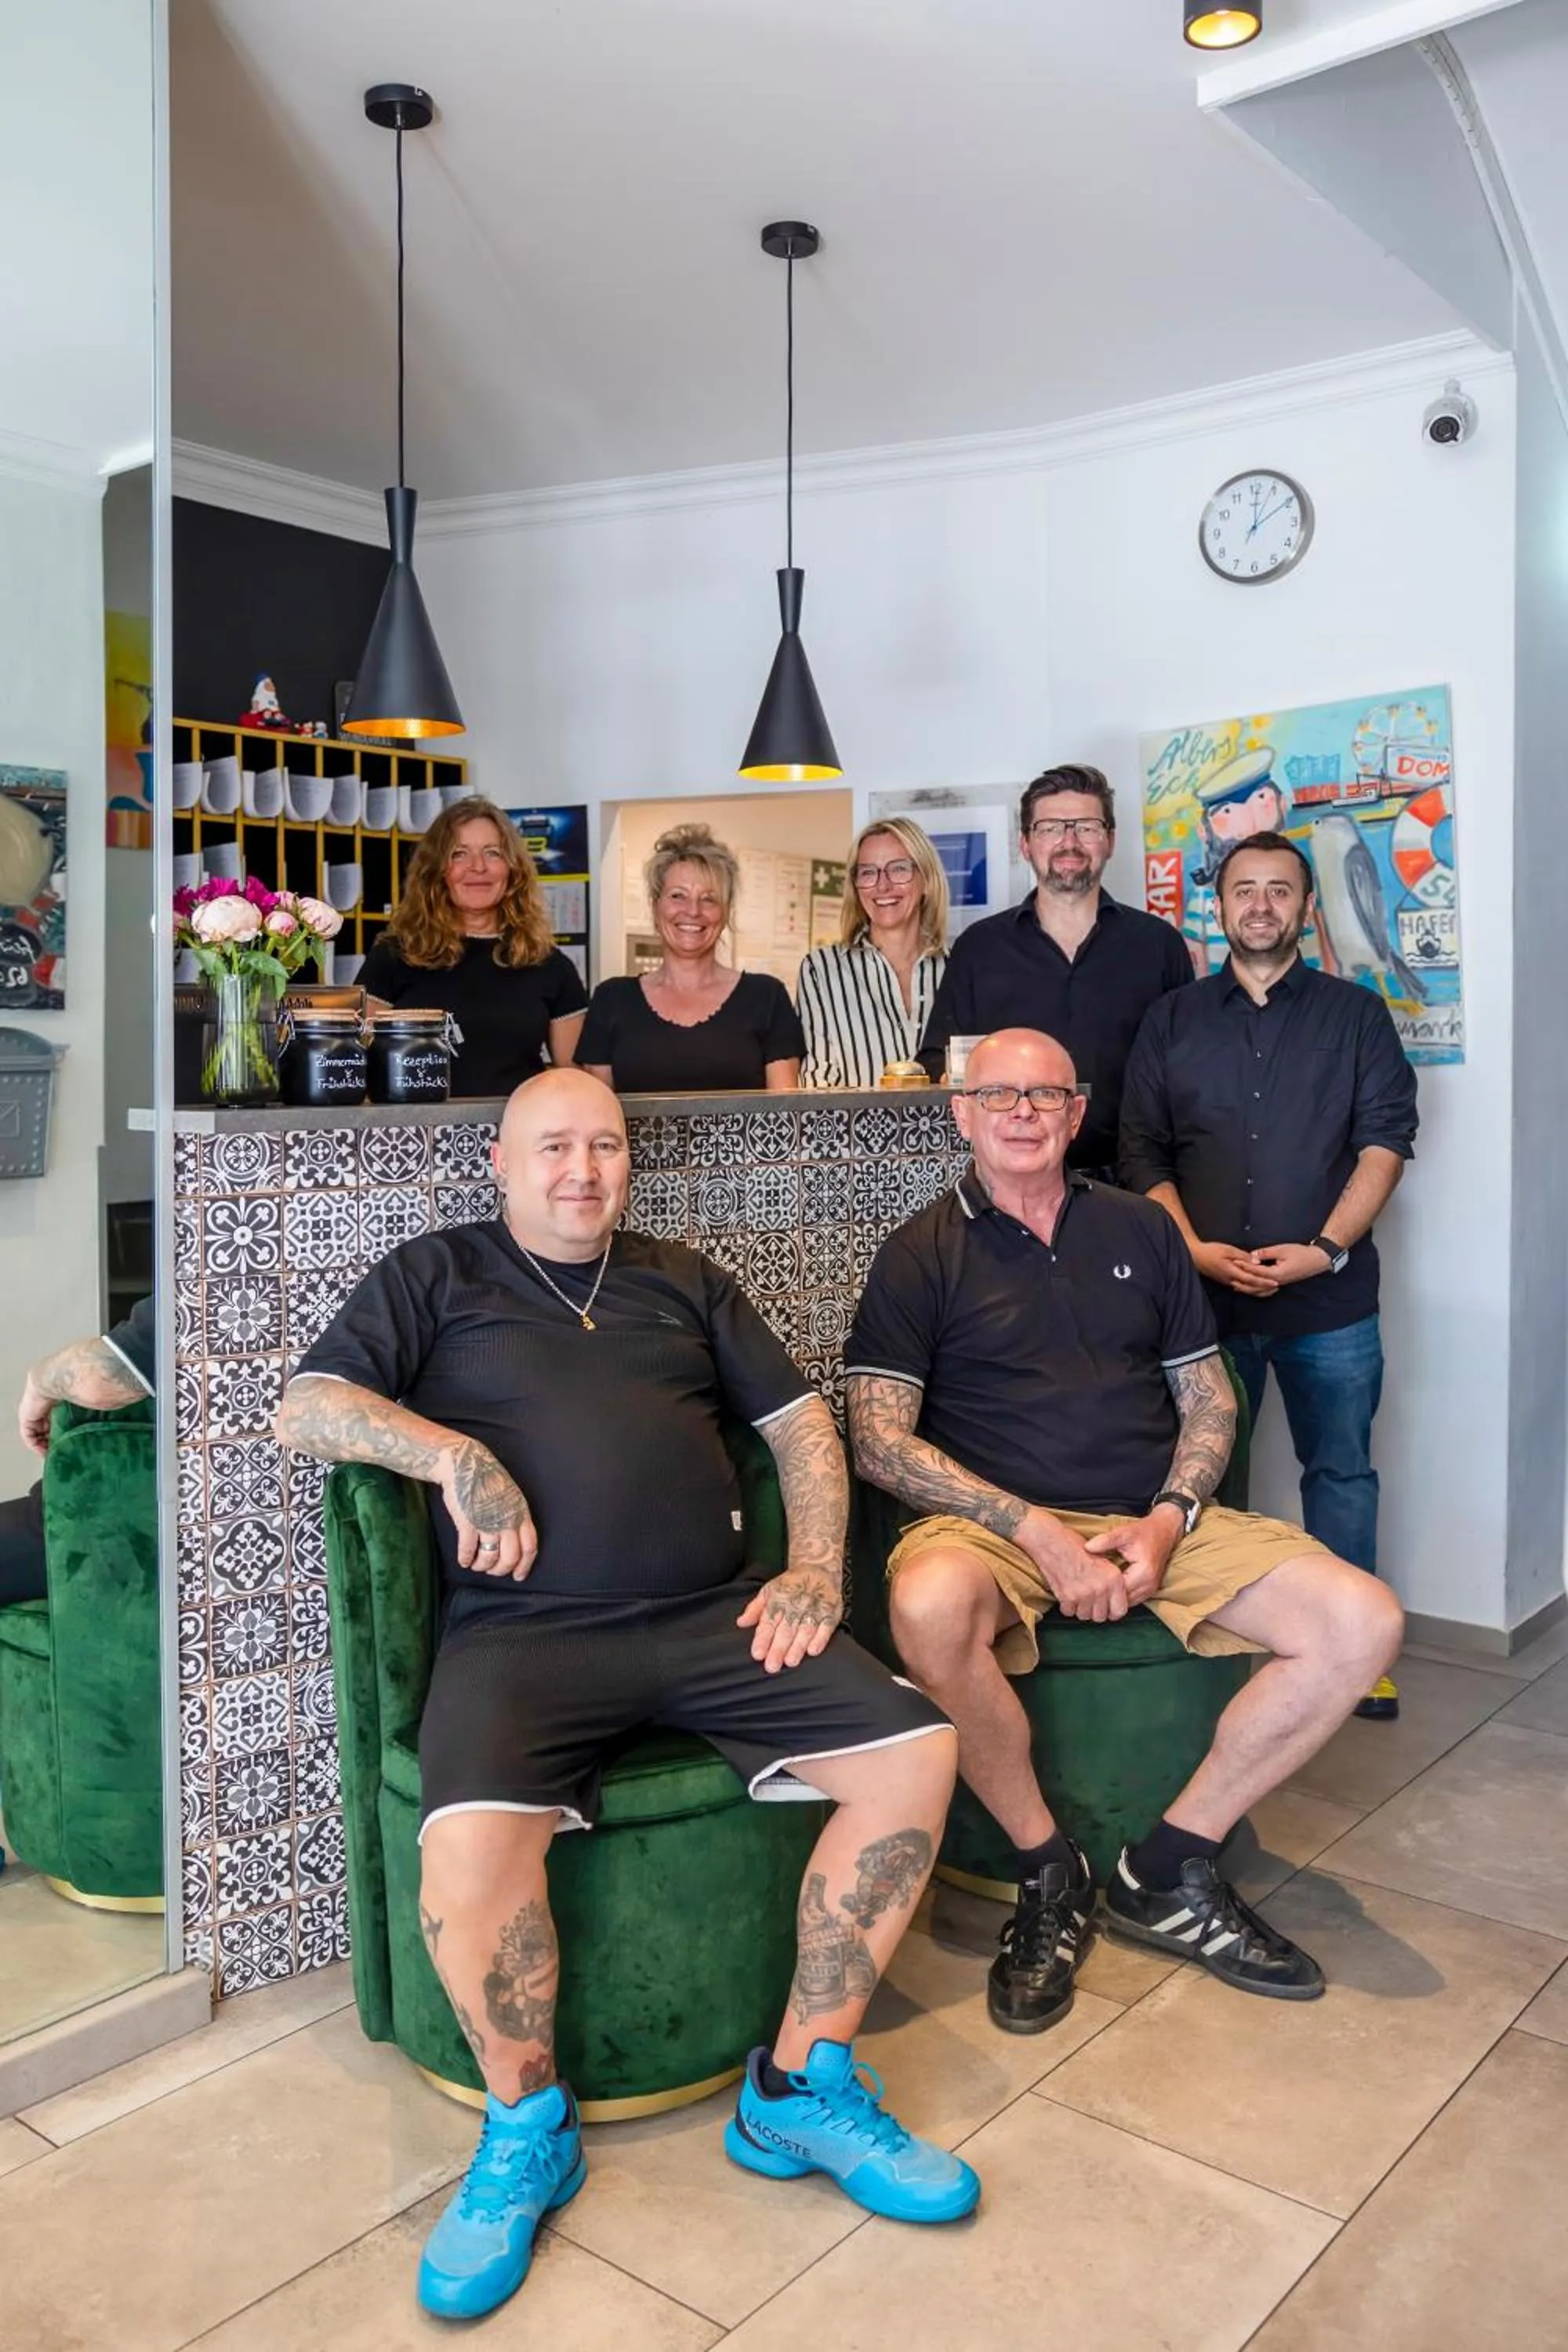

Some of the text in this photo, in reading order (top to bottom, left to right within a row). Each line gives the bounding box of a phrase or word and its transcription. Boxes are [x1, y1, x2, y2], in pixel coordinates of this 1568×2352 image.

[1250, 482, 1261, 495] 12
[1232, 493, 1241, 505] 11
[1218, 510, 1230, 521] 10
[1290, 517, 1298, 528] 3
[1213, 528, 1221, 540] 9
[1283, 537, 1291, 547] 4
[1219, 547, 1225, 558] 8
[1233, 558, 1240, 571] 7
[1269, 554, 1278, 565] 5
[1250, 561, 1258, 573] 6
[1397, 755, 1450, 777] DOM
[746, 2110, 812, 2159] LACOSTE
